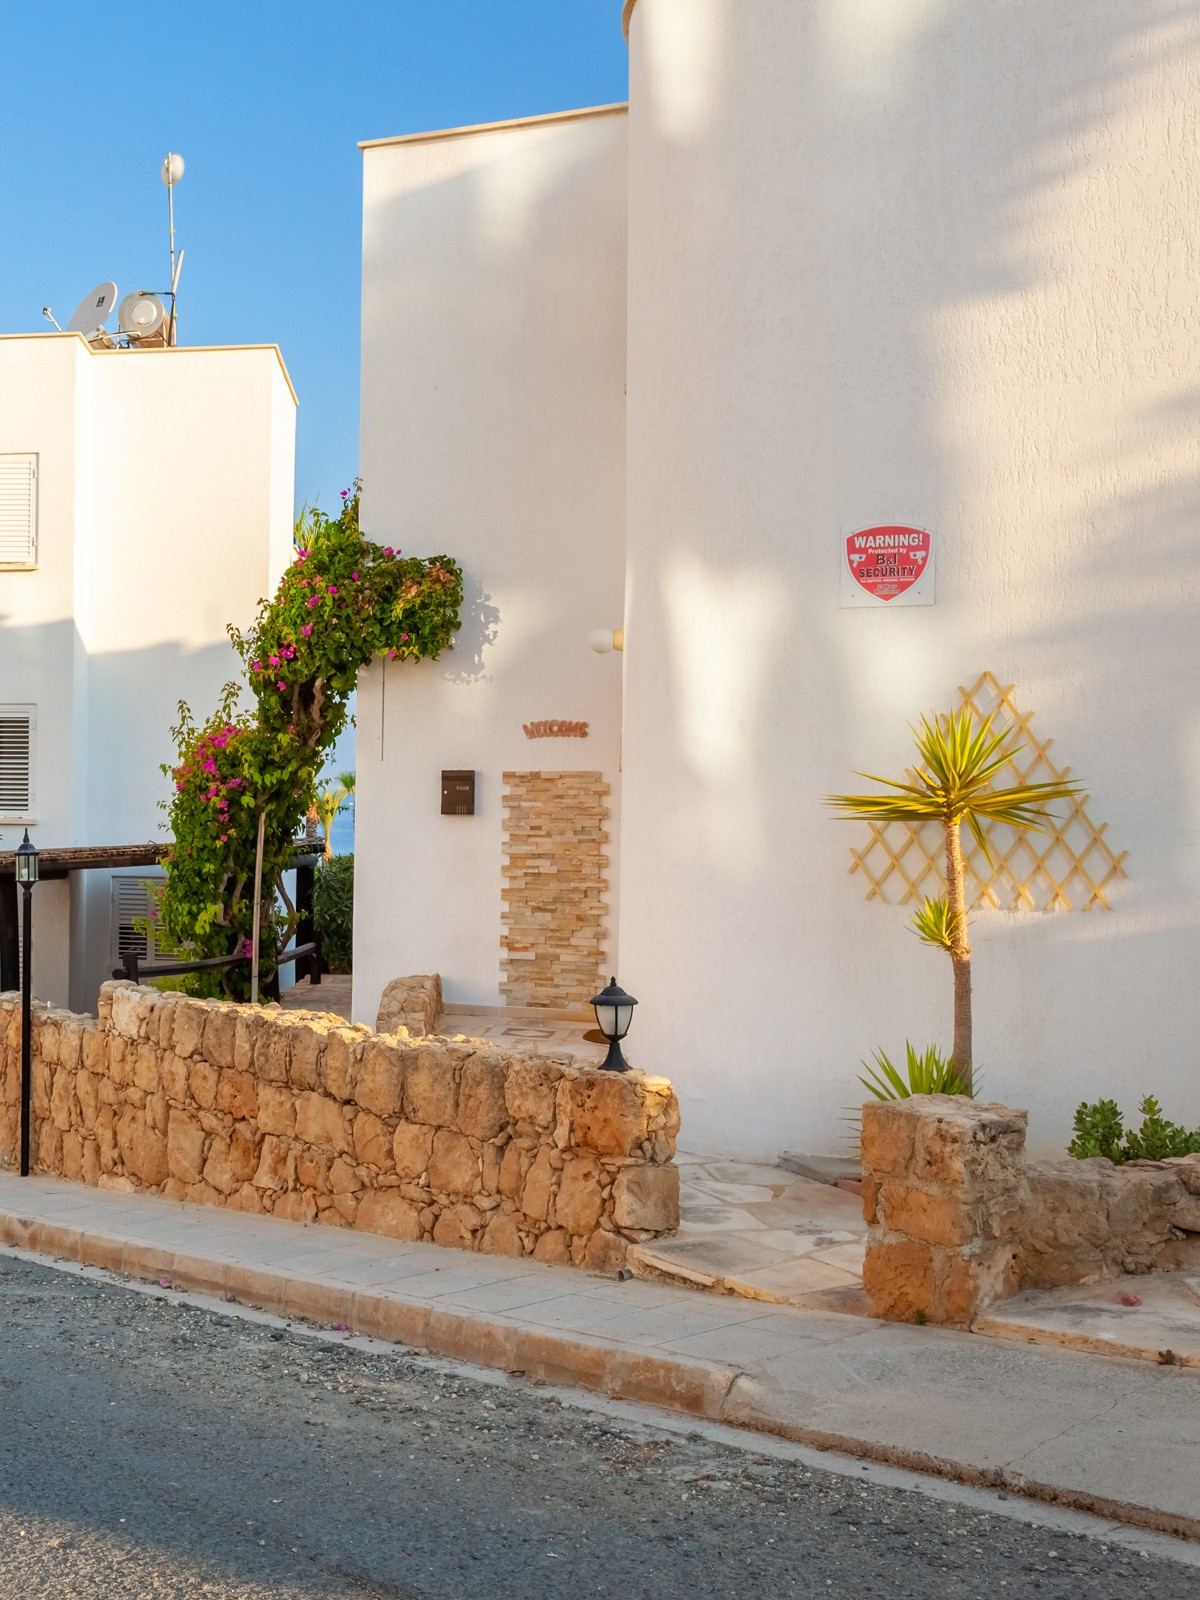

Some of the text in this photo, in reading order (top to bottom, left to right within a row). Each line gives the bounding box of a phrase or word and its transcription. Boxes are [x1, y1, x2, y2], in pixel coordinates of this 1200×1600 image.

[853, 534, 923, 548] WARNING!
[859, 566, 916, 578] SECURITY
[522, 719, 589, 739] WELCOME
